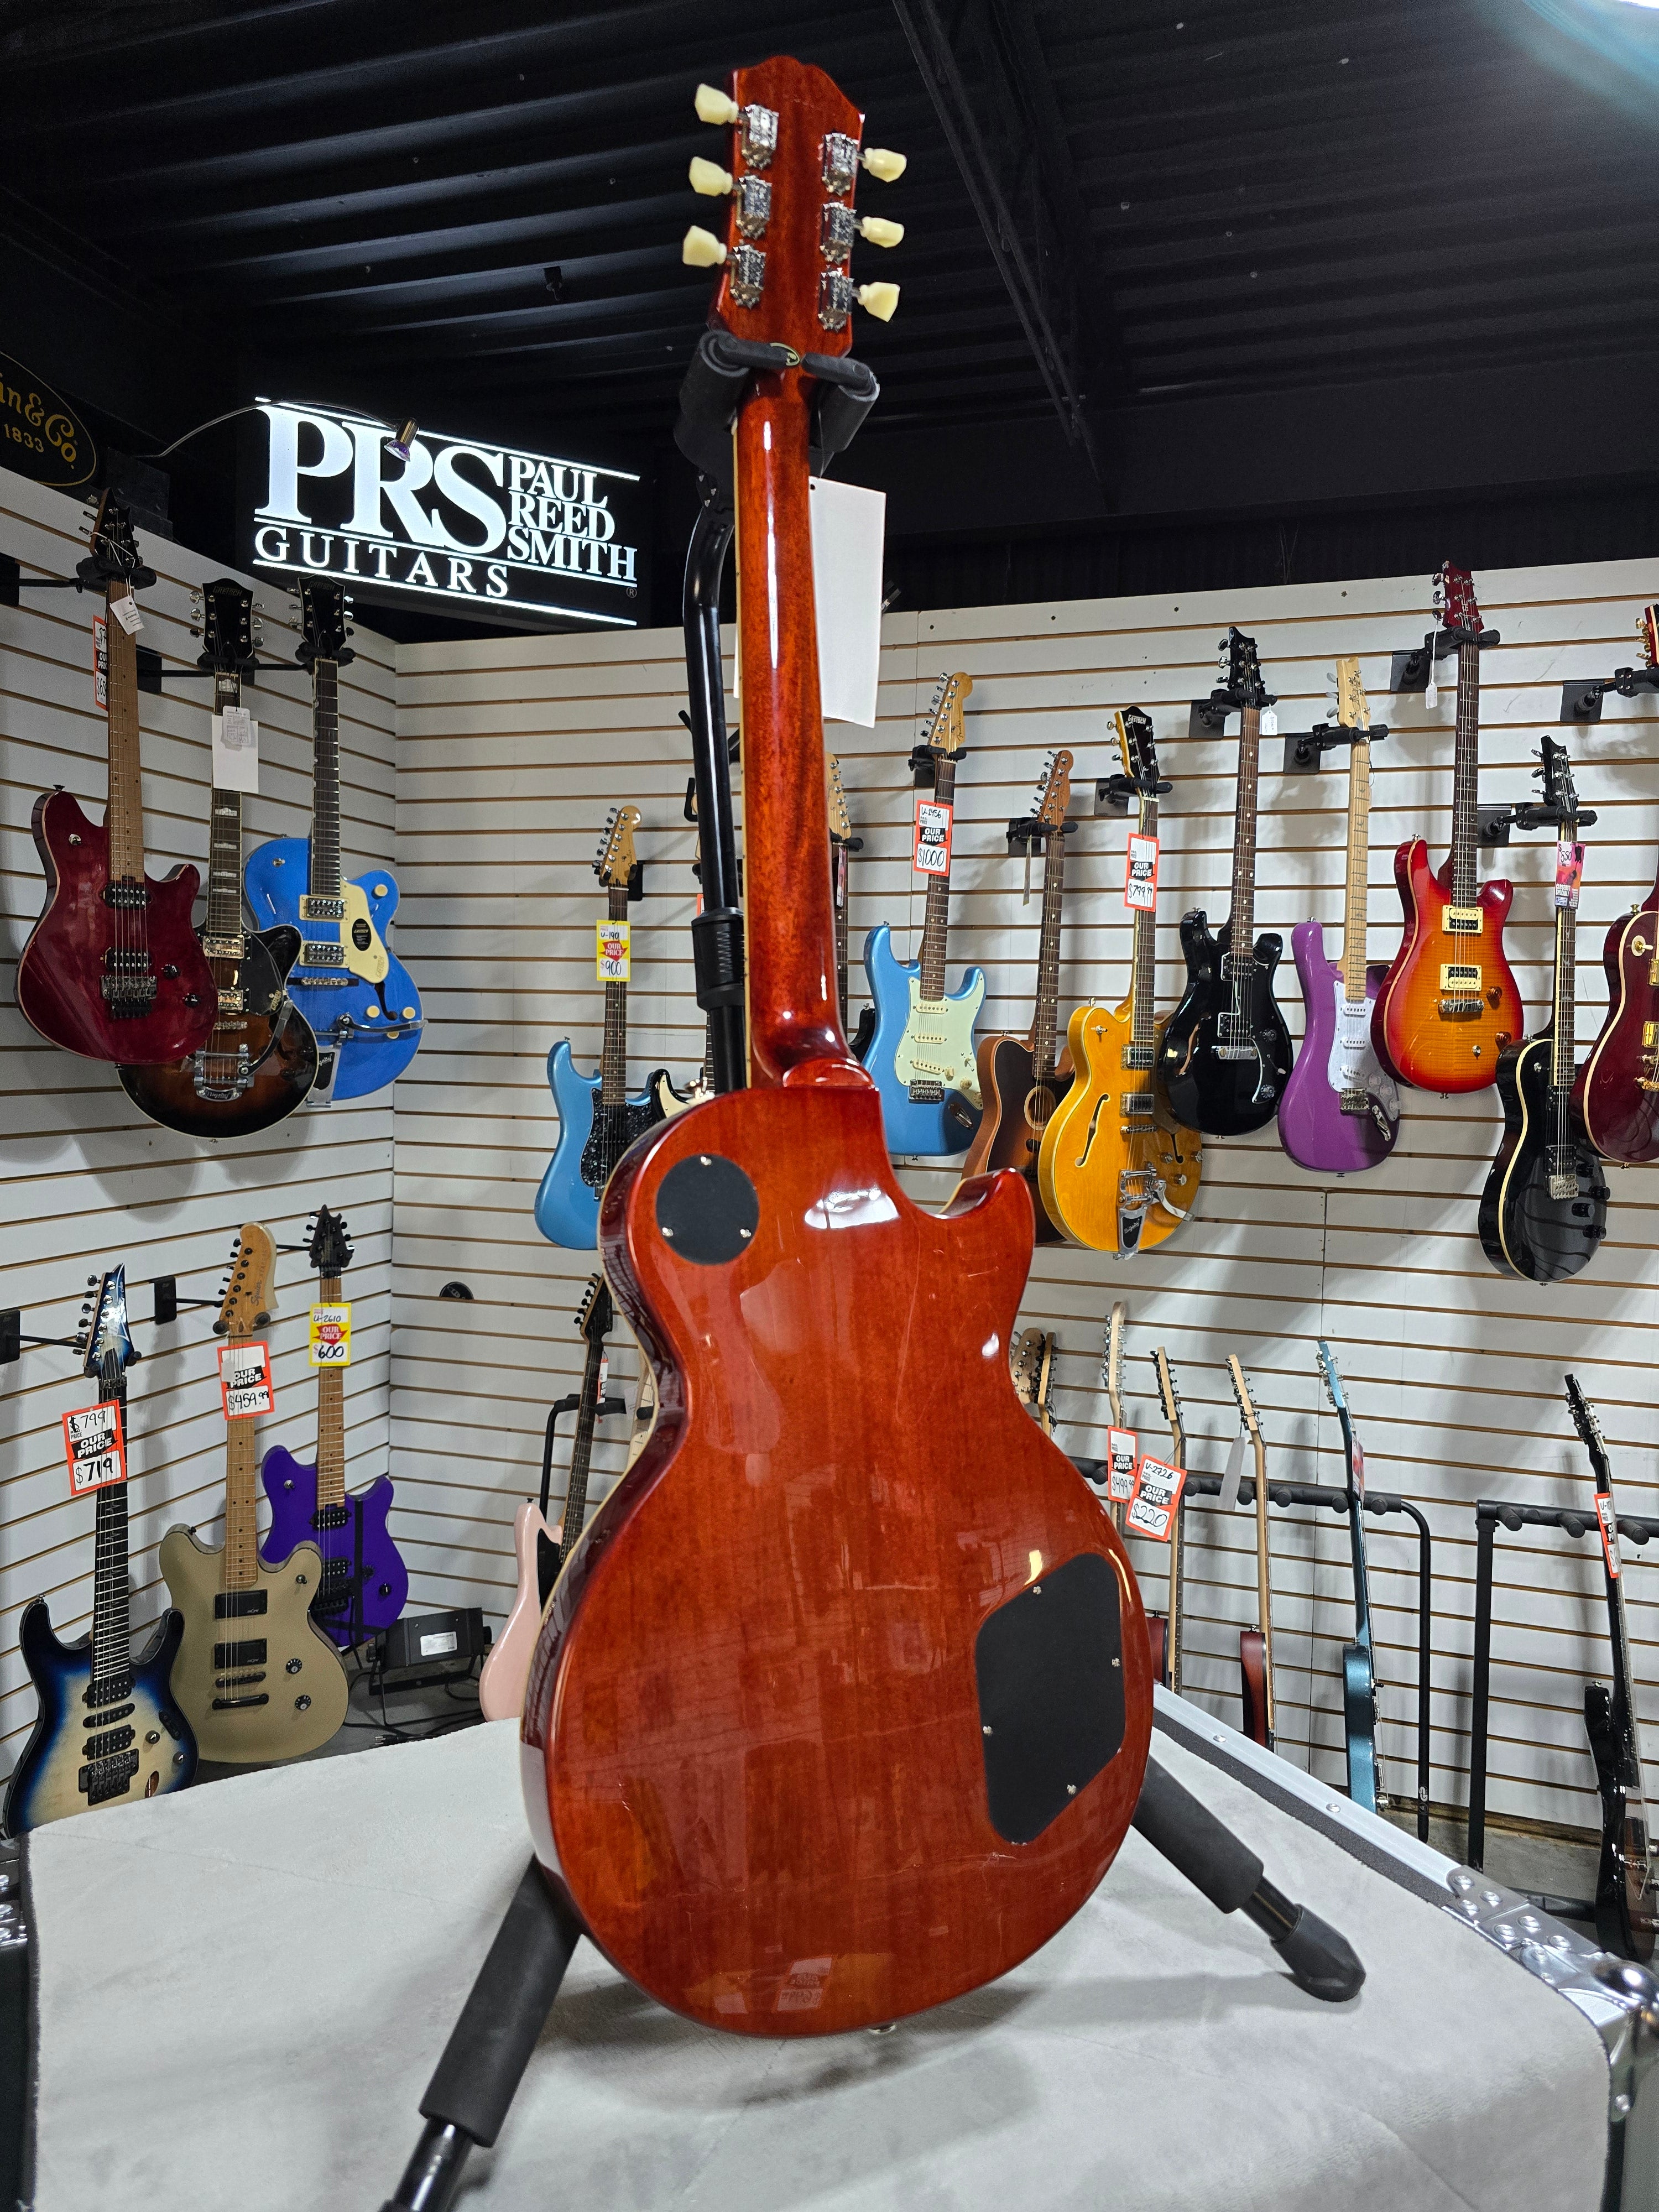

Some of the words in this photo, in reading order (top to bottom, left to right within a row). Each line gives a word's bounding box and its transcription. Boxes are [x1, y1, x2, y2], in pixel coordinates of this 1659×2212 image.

[4, 424, 44, 452] 1833
[254, 405, 507, 554] PRS
[508, 456, 608, 508] PAUL
[508, 491, 615, 541] REED
[255, 526, 508, 598] GUITARS
[507, 526, 638, 581] SMITH
[1128, 714, 1147, 725] GRETSCH
[918, 847, 945, 867] $1000
[1131, 868, 1152, 877] PRICE
[600, 960, 622, 976] $900
[1124, 1218, 1140, 1234] Bigsby
[251, 1280, 262, 1306] Squier
[313, 1344, 345, 1359] $600
[229, 1373, 262, 1389] PRICE
[234, 1368, 255, 1380] OUR
[69, 1410, 106, 1433] $799
[77, 1437, 112, 1459] PRICE
[80, 1432, 106, 1448] OUR
[1114, 1462, 1133, 1470] PRICE
[1116, 1454, 1130, 1463] OUR
[75, 1457, 113, 1485] $719
[1140, 1492, 1170, 1505] PRICE
[1145, 1485, 1166, 1496] OUR
[1131, 1502, 1168, 1527] $220
